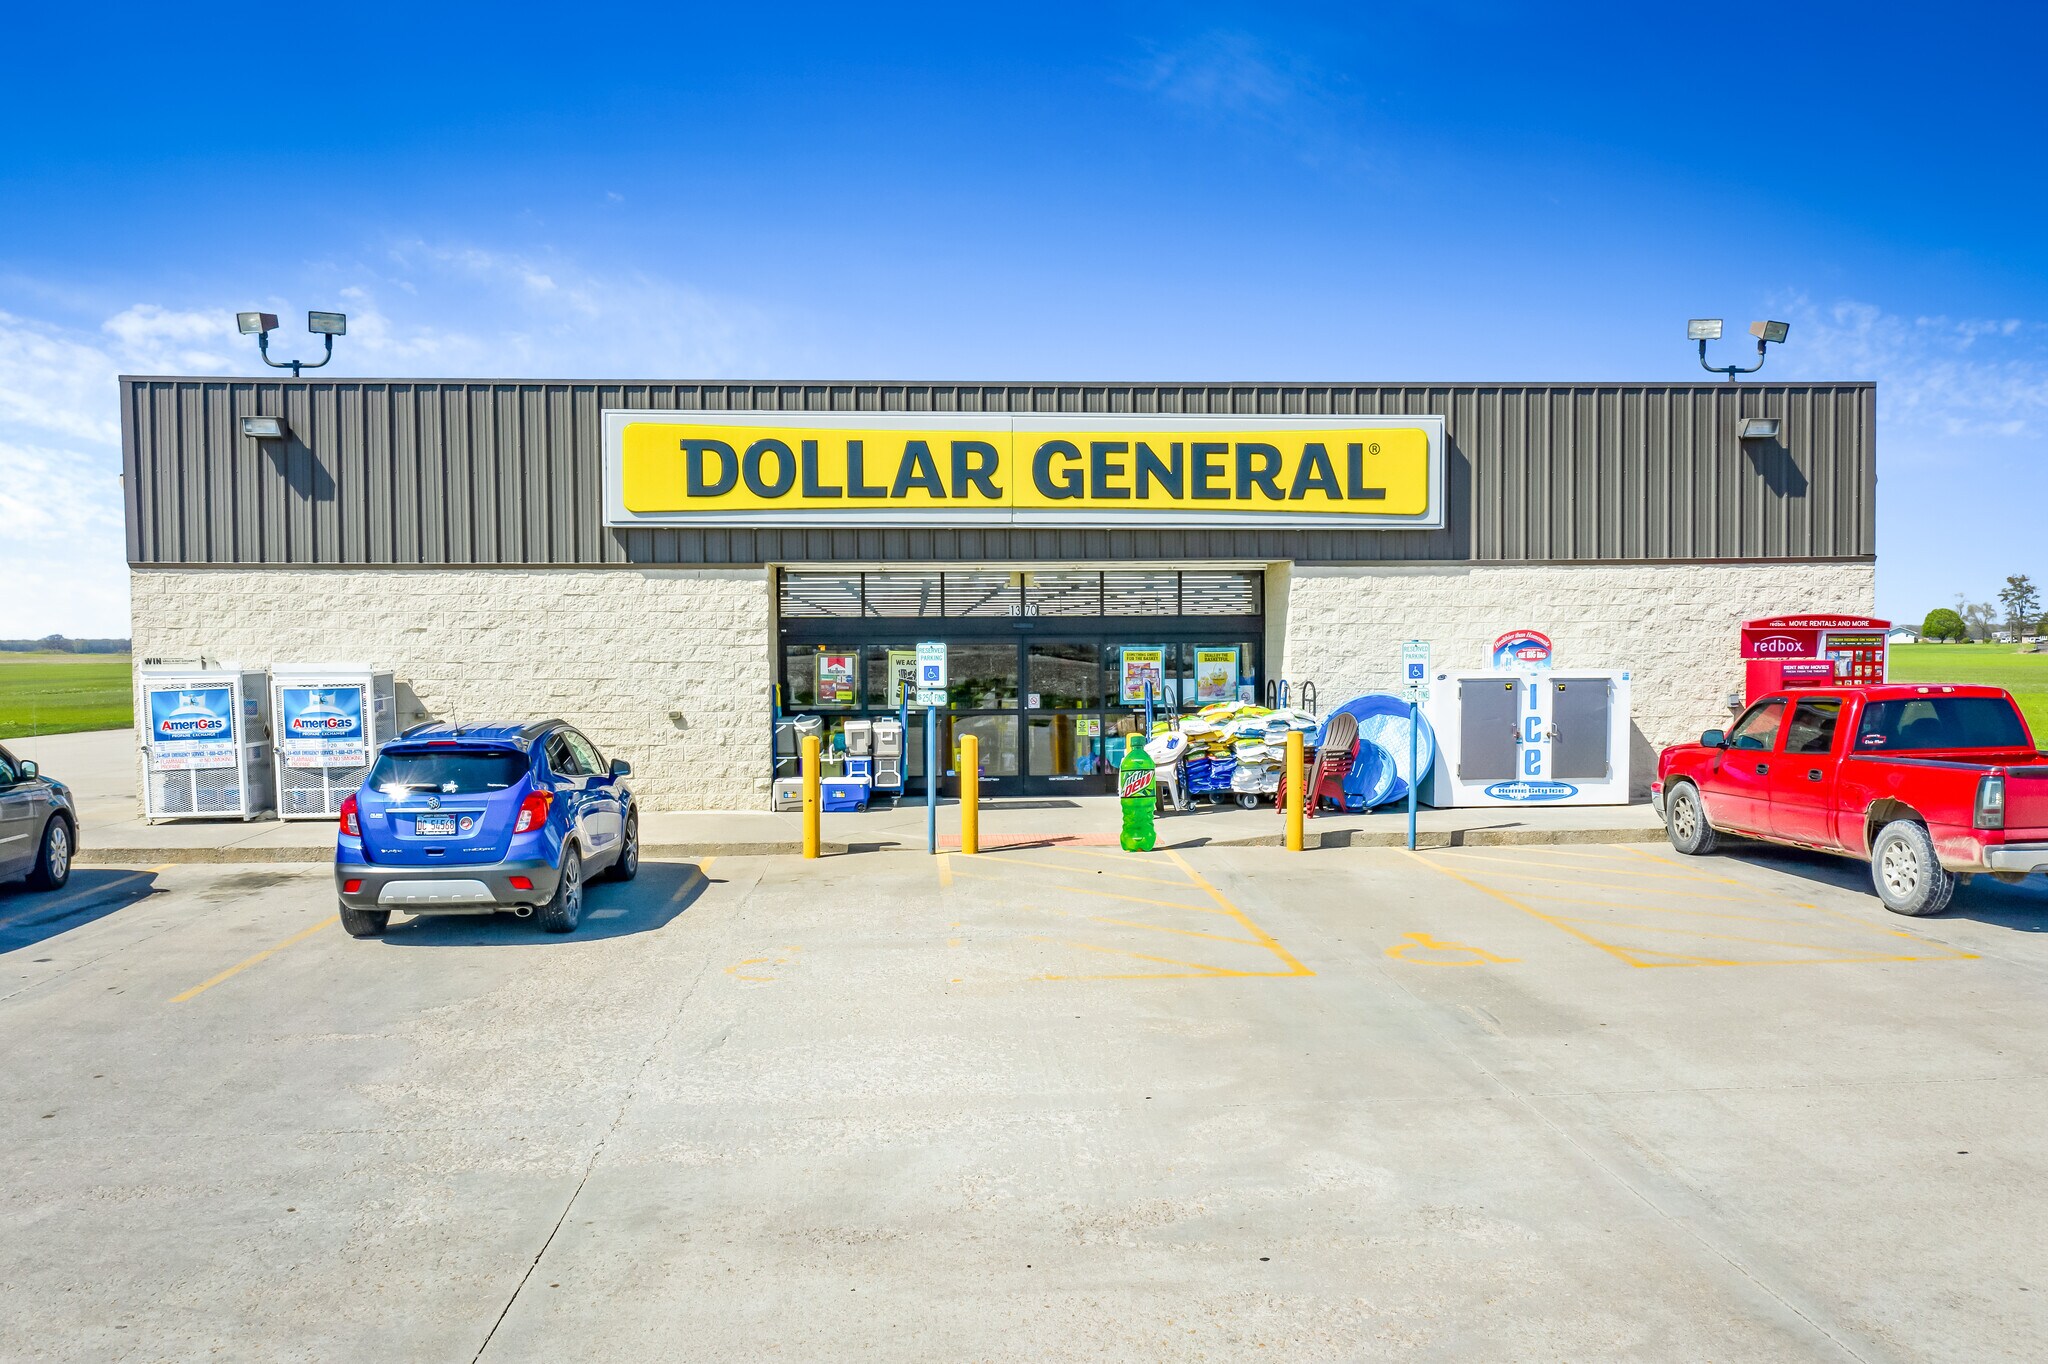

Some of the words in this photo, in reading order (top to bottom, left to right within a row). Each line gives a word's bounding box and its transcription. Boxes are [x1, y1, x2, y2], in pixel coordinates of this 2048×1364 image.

[680, 438, 1003, 499] DOLLAR
[1753, 639, 1804, 652] redbox
[934, 693, 946, 702] FINE
[1418, 691, 1429, 699] FINE
[162, 719, 223, 731] AmeriGas
[293, 718, 353, 729] AmeriGas
[1528, 788, 1548, 796] City
